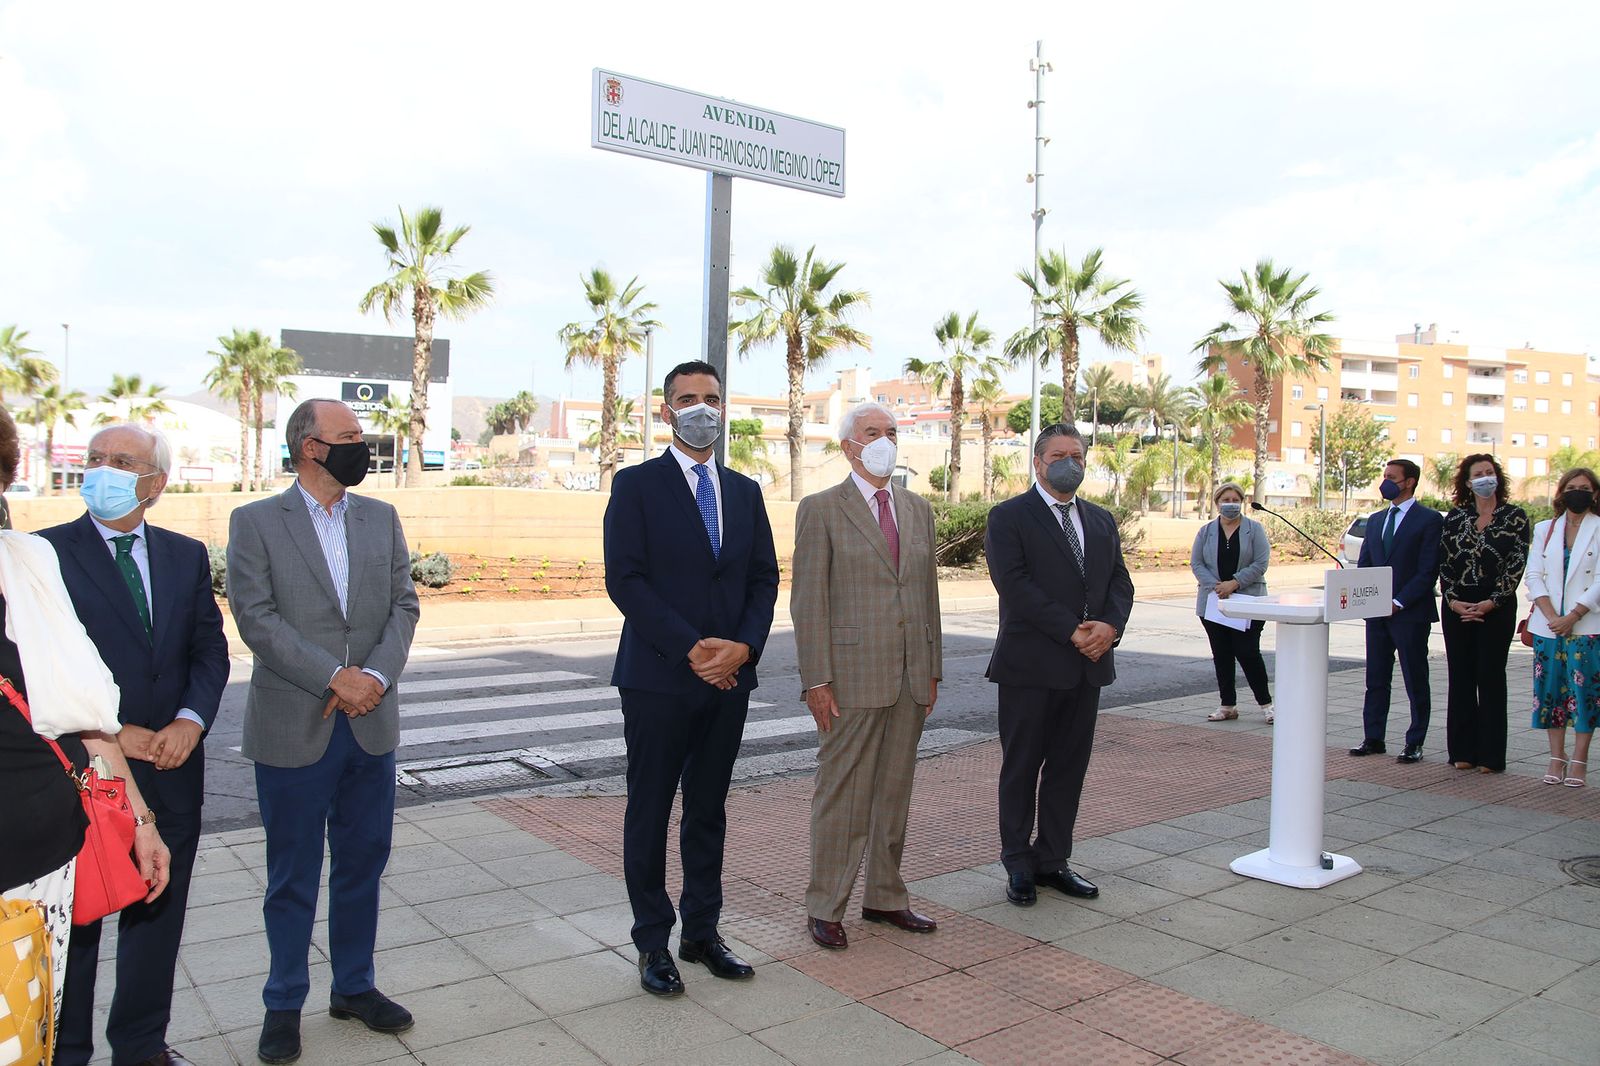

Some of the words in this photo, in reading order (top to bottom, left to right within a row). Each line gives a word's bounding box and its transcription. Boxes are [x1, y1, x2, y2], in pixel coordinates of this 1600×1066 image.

[702, 104, 776, 135] AVENIDA
[603, 110, 625, 140] DEL
[626, 116, 676, 151] ALCALDE
[678, 127, 707, 158] JUAN
[709, 134, 768, 171] FRANCISCO
[770, 147, 808, 180] MEGINO
[810, 153, 841, 187] LÓPEZ
[1352, 584, 1379, 597] ALMERÍA
